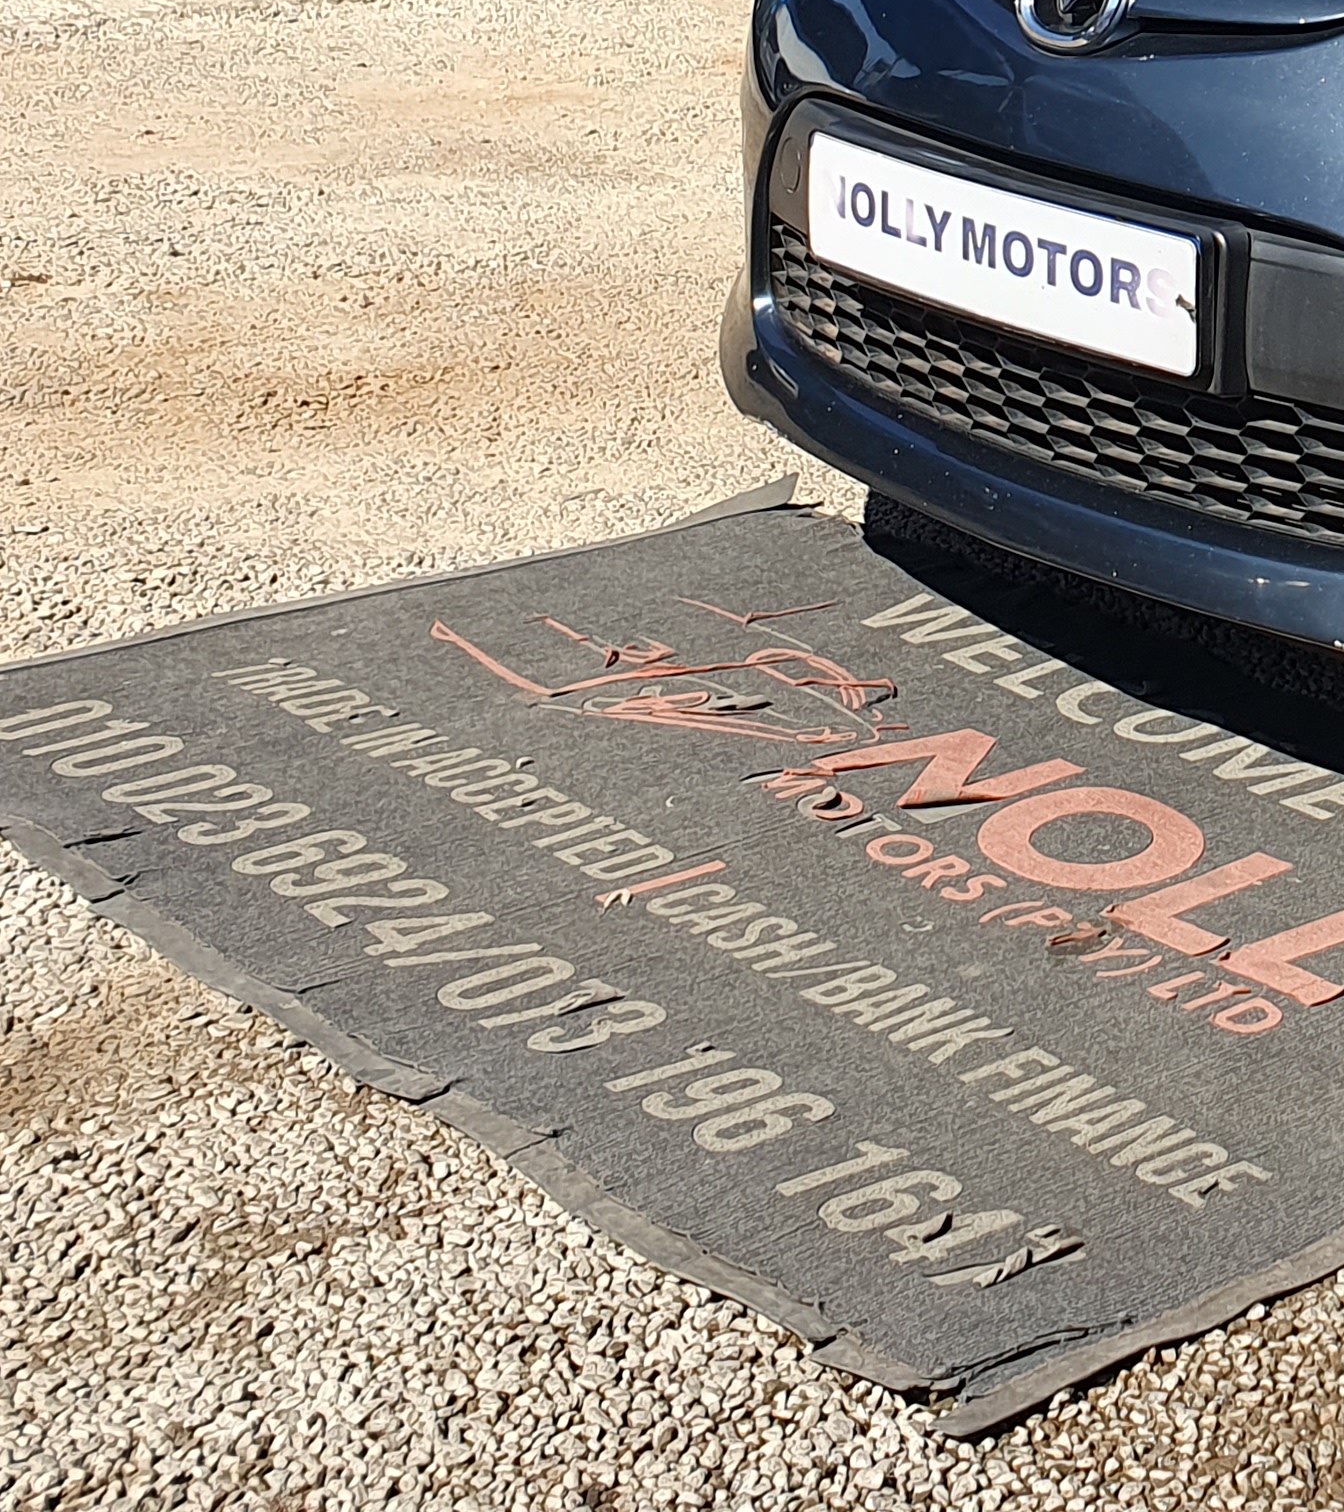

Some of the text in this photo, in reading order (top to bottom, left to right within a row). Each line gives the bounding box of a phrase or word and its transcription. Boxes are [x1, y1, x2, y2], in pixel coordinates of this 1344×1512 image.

[961, 216, 1176, 317] MOTORS
[211, 657, 400, 734] TRADE
[339, 722, 450, 758] IN
[390, 746, 676, 881] ACCEPTED
[101, 763, 312, 846] 023
[603, 1040, 836, 1153] 196
[646, 883, 1014, 1065] CASH/BANK
[757, 768, 1007, 902] MOTORS
[1146, 970, 1284, 1035] LTD
[958, 1045, 1274, 1208] FINANCE
